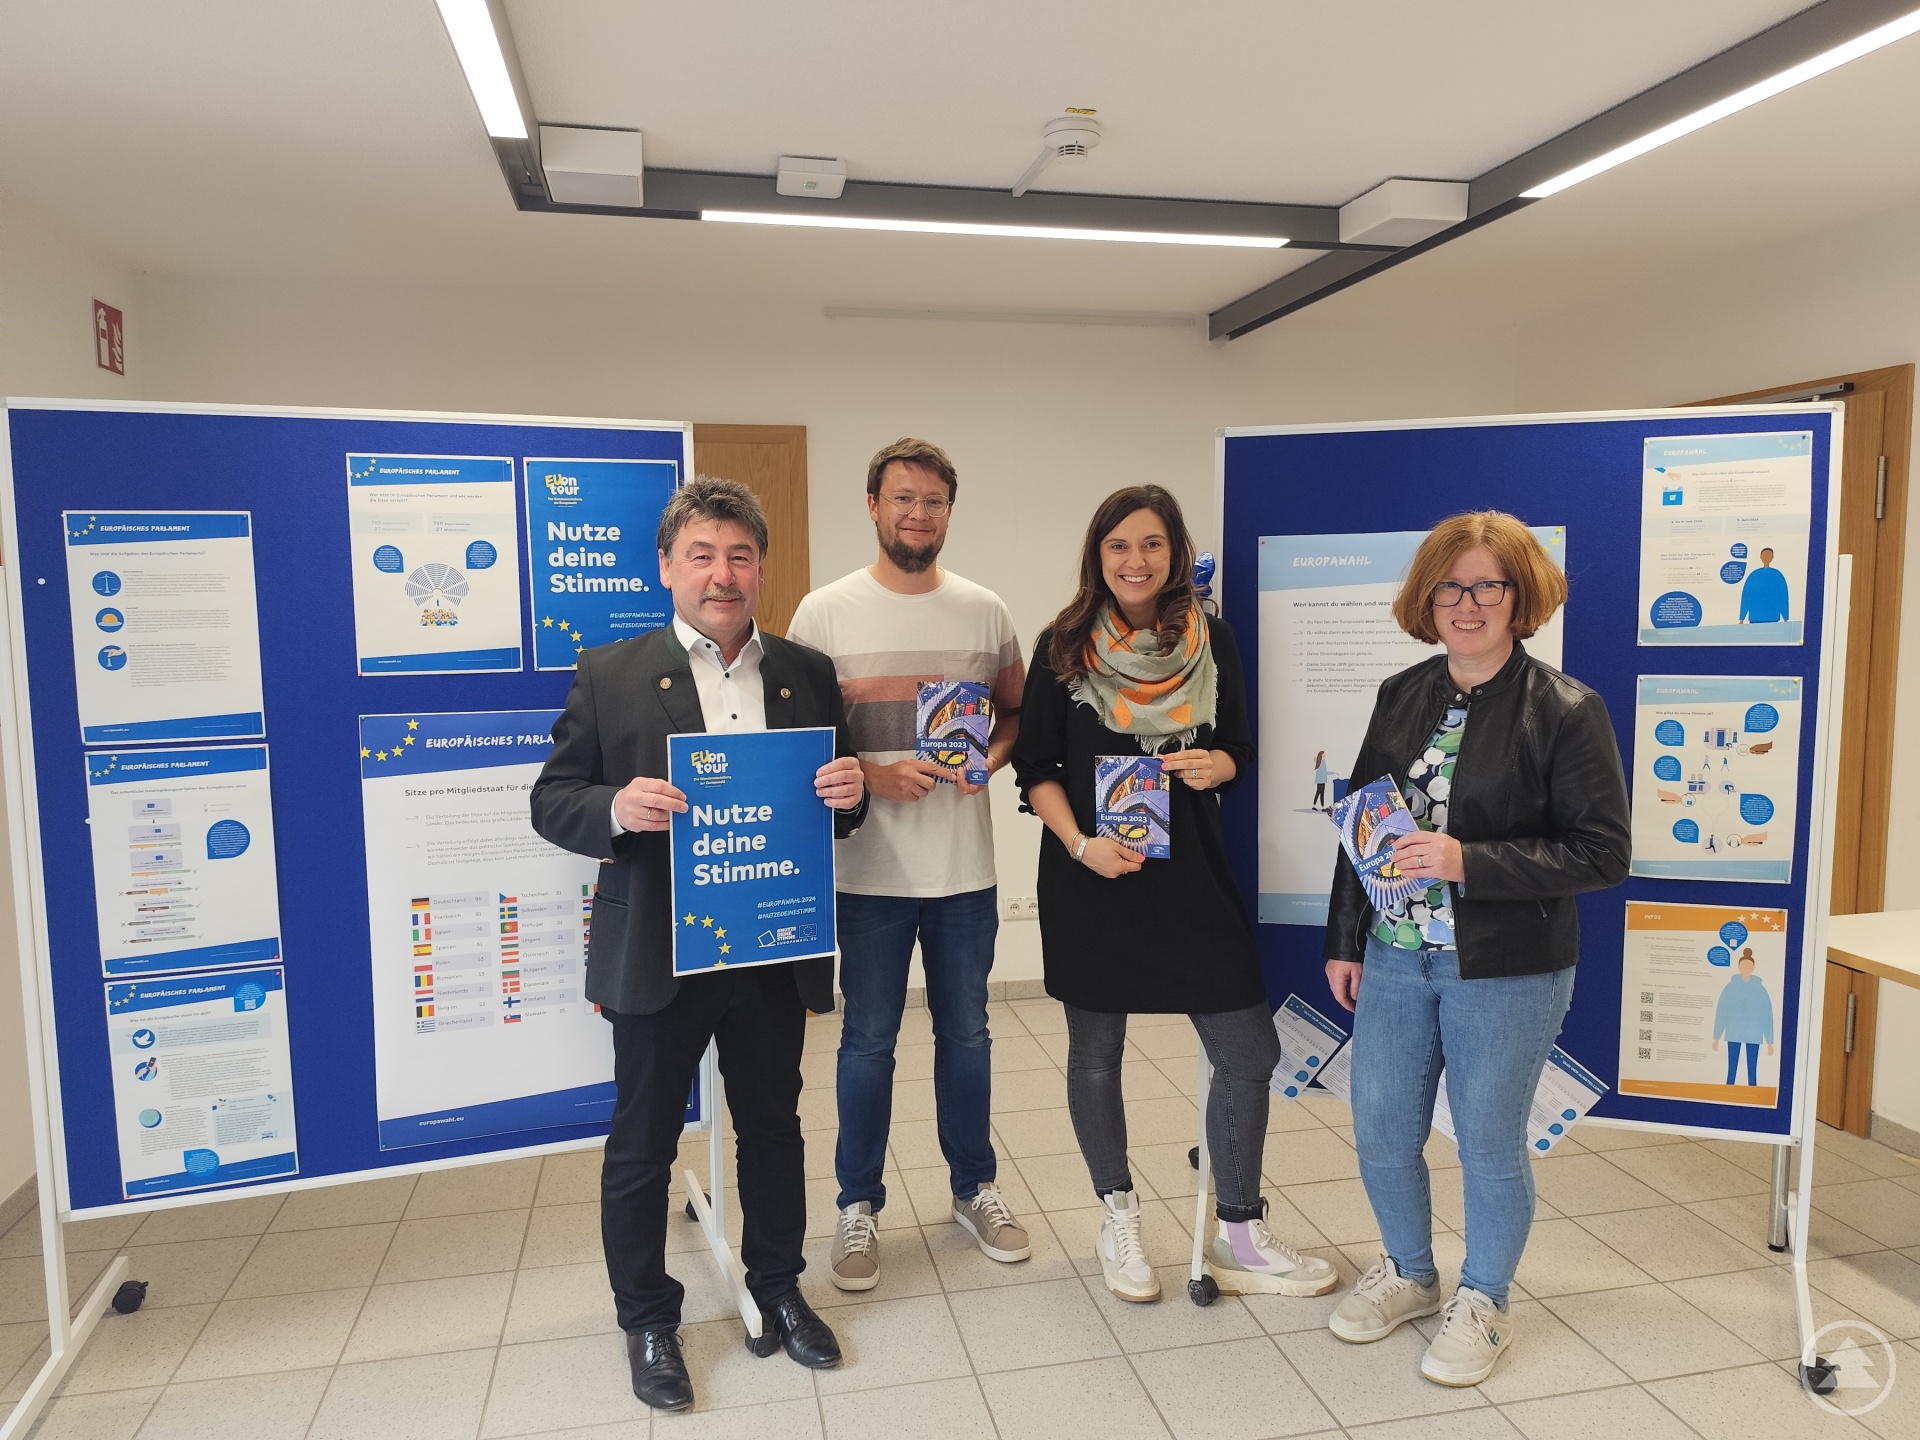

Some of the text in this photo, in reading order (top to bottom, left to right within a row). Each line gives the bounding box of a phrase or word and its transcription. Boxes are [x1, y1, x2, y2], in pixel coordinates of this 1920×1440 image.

[380, 467, 423, 475] EUROPÄISCHES
[550, 484, 579, 495] tour
[547, 522, 621, 541] Nutze
[548, 546, 616, 567] deine
[1293, 556, 1372, 568] EUROPAWAHL
[550, 573, 650, 593] Stimme.
[426, 734, 555, 748] EUROPÄISCHES PARLA
[920, 741, 948, 749] Europa
[121, 760, 210, 770] EUROPÄISCHES PARLAMENT
[695, 762, 728, 774] tour
[430, 789, 444, 797] pro
[447, 785, 504, 795] Mitgliedstaat
[692, 804, 772, 827] Nutze
[1100, 814, 1148, 823] Europa 2023
[692, 831, 766, 856] deine
[1358, 856, 1384, 872] Europa
[694, 859, 800, 885] Stimme.
[757, 895, 816, 908] #EUROPAWAHL2024
[140, 989, 187, 998] EUROPÄISCHES
[188, 985, 227, 995] PARLAMENT
[439, 1018, 472, 1026] Griechenland
[419, 1116, 464, 1126] europawahl.eu
